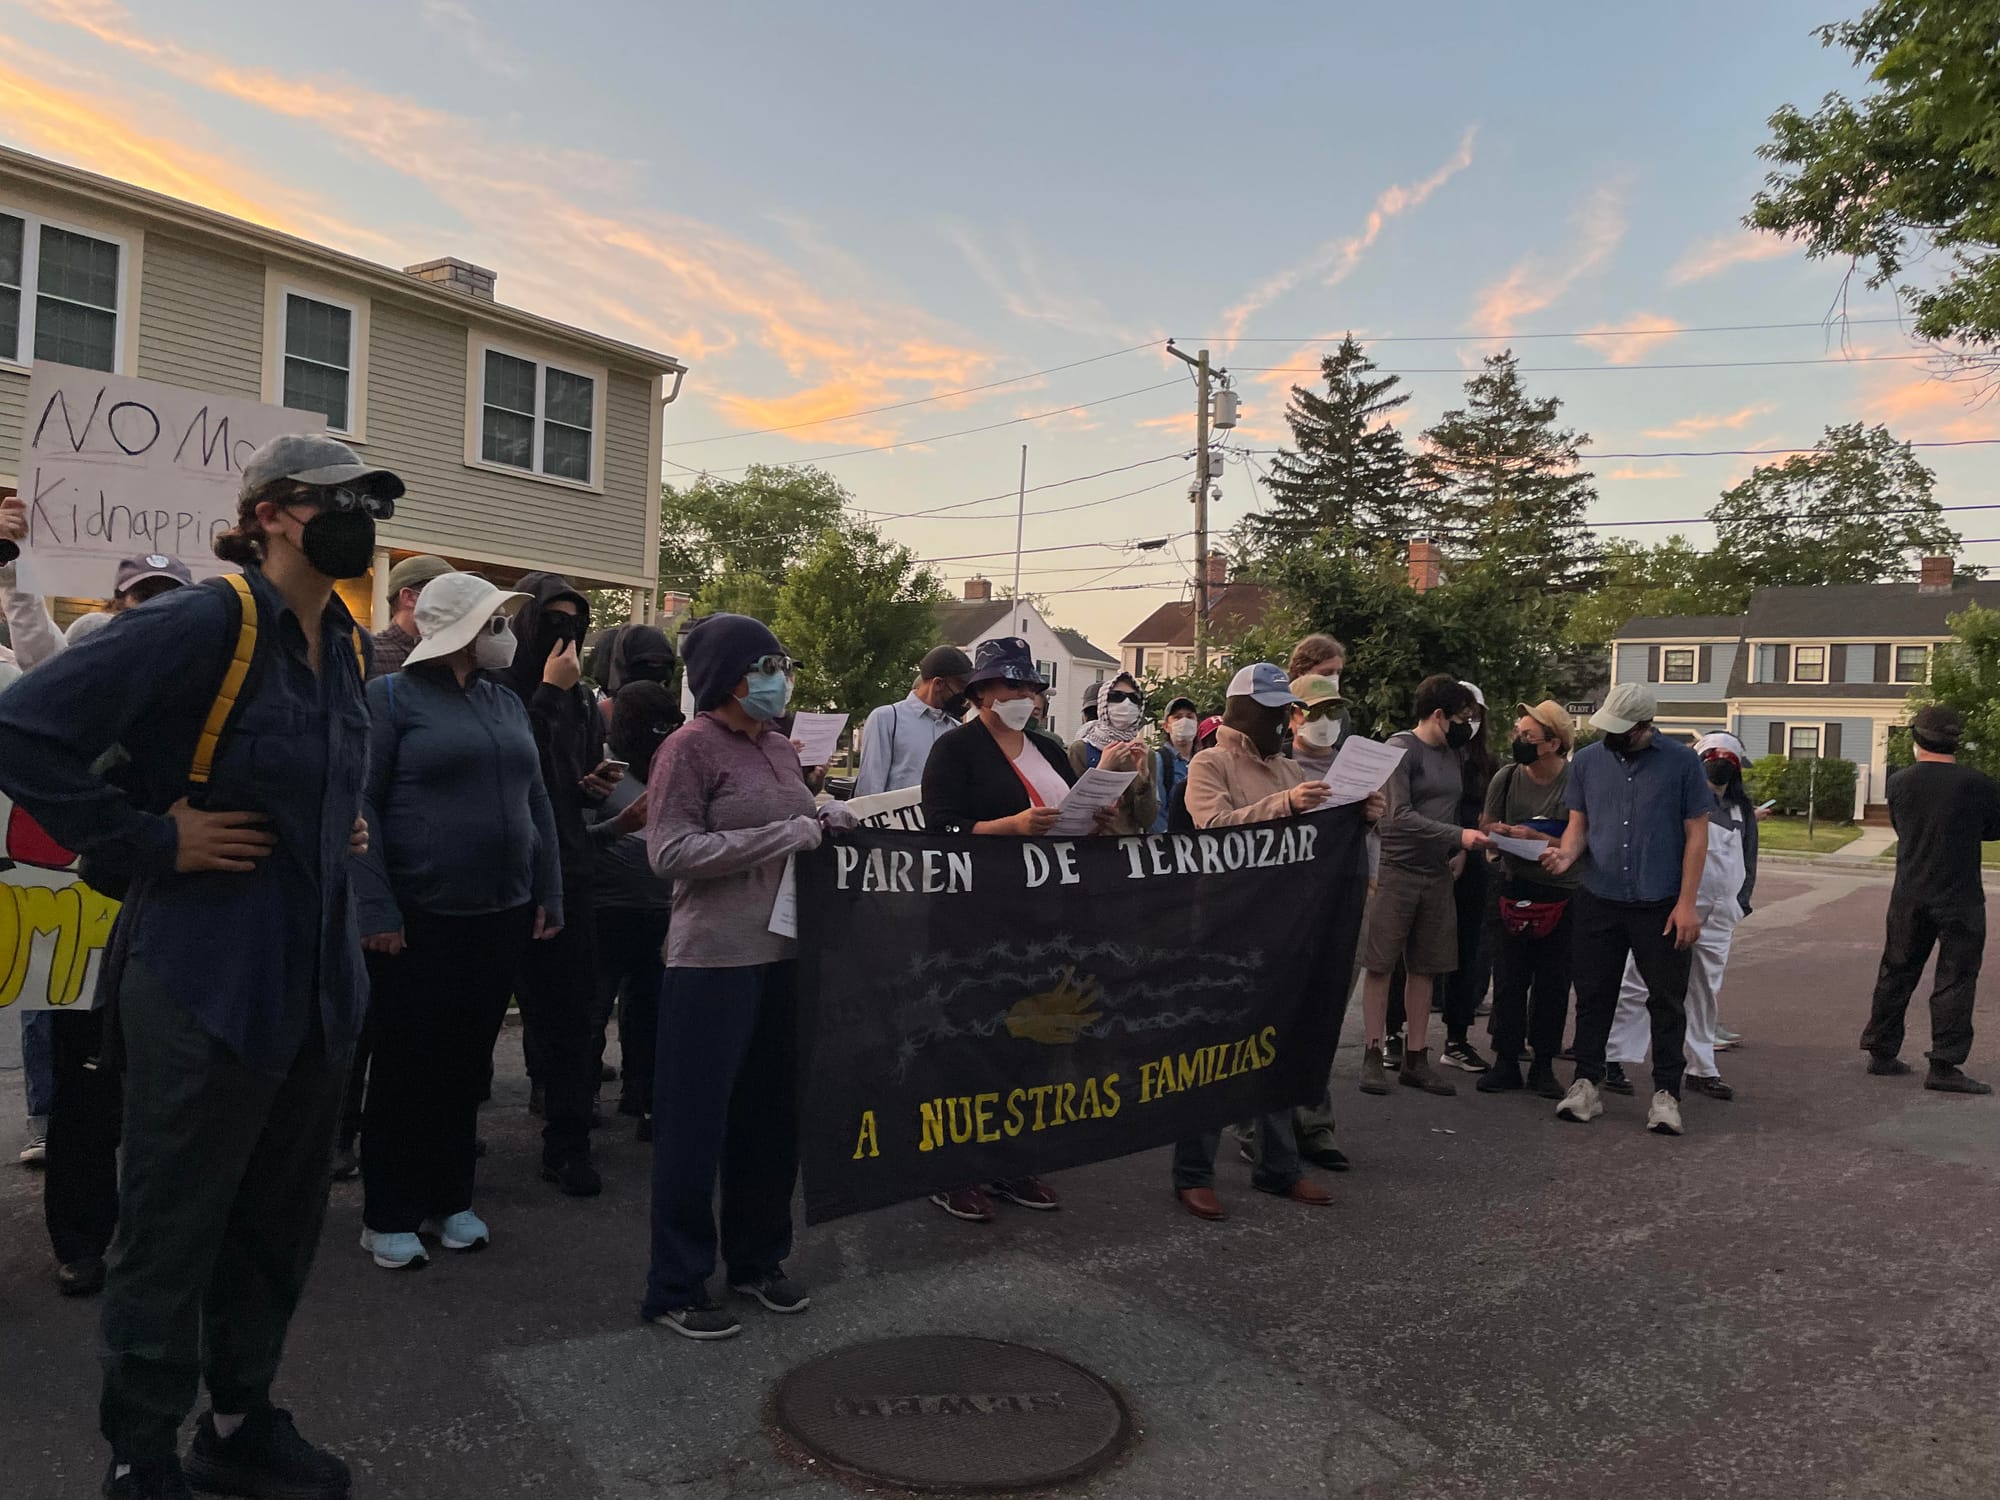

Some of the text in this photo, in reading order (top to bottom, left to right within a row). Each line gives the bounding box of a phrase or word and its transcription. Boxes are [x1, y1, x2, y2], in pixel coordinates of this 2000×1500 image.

[32, 386, 257, 472] NO Mo
[30, 467, 232, 554] Kidnappin
[833, 824, 1319, 893] PAREN DE TERROIZAR
[858, 811, 891, 828] UE
[852, 1025, 1277, 1160] A NUESTRAS FAMILIAS
